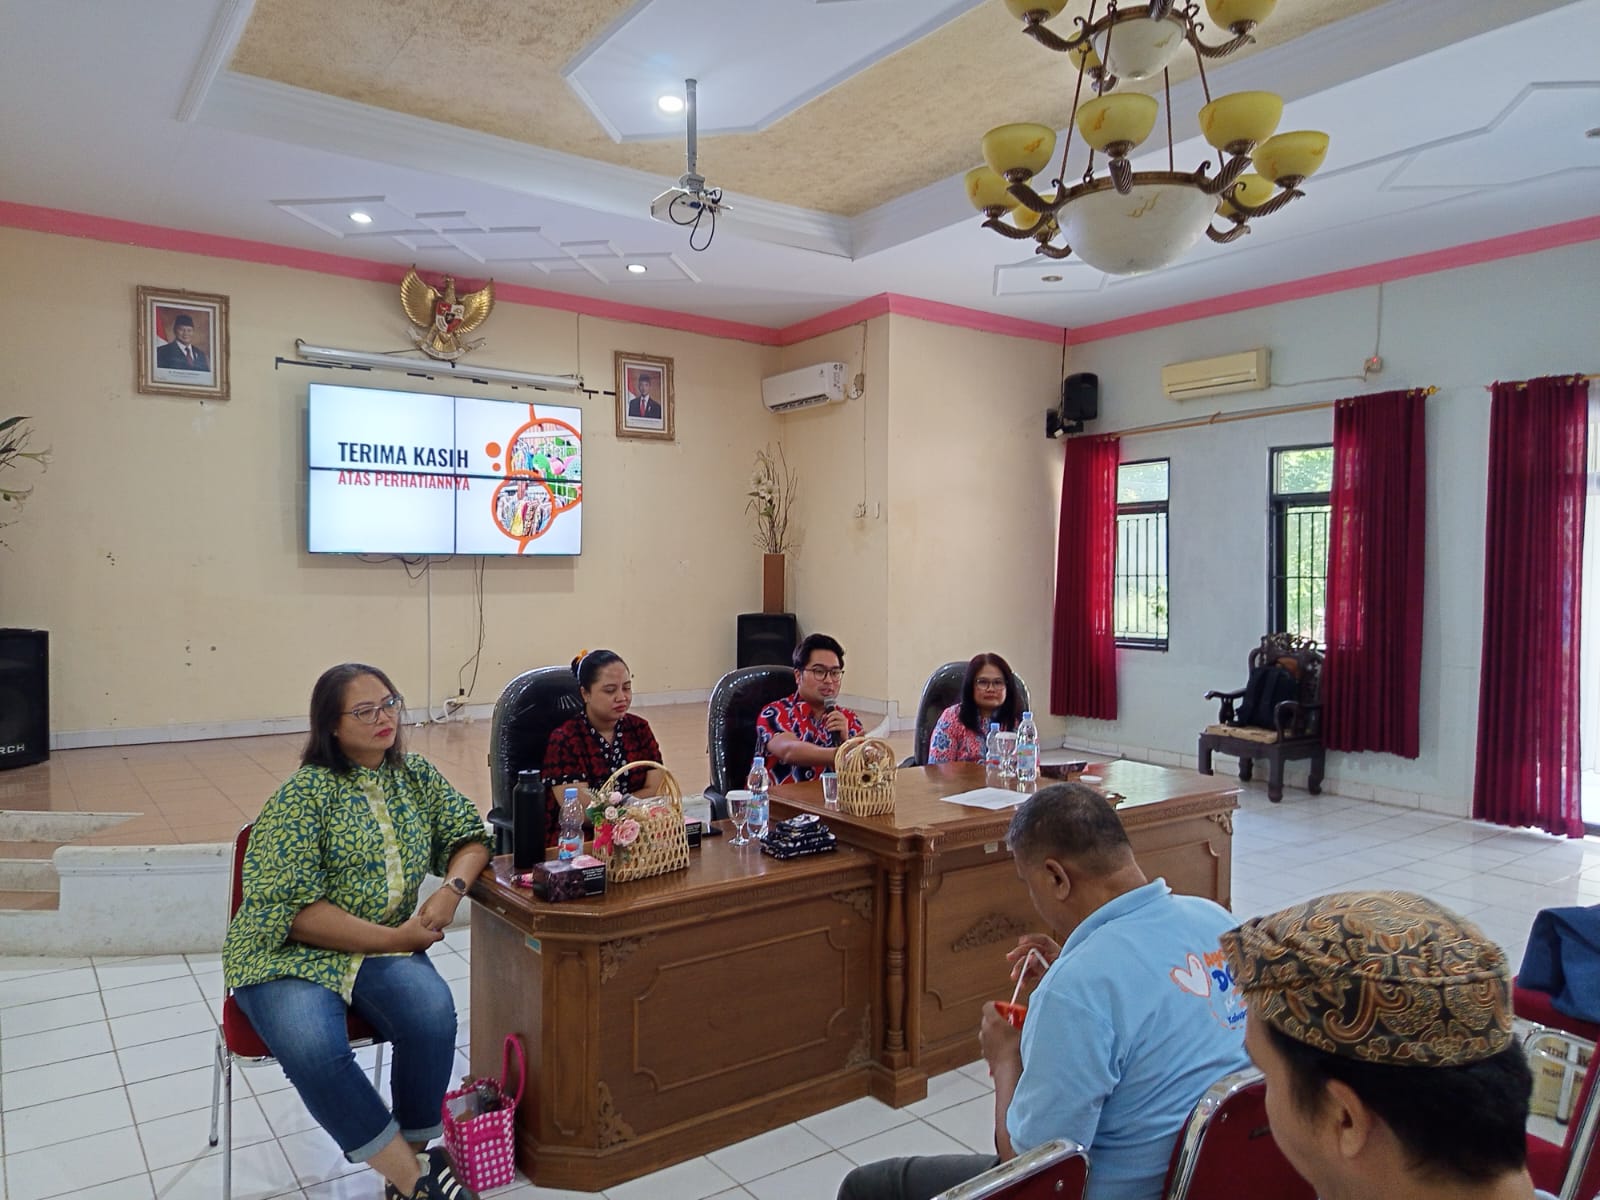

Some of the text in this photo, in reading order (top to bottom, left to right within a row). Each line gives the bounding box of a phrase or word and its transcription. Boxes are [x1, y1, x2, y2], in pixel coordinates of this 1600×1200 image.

[338, 442, 468, 468] TERIMA KASIH
[337, 469, 470, 490] ATAS PERHATIANNYA
